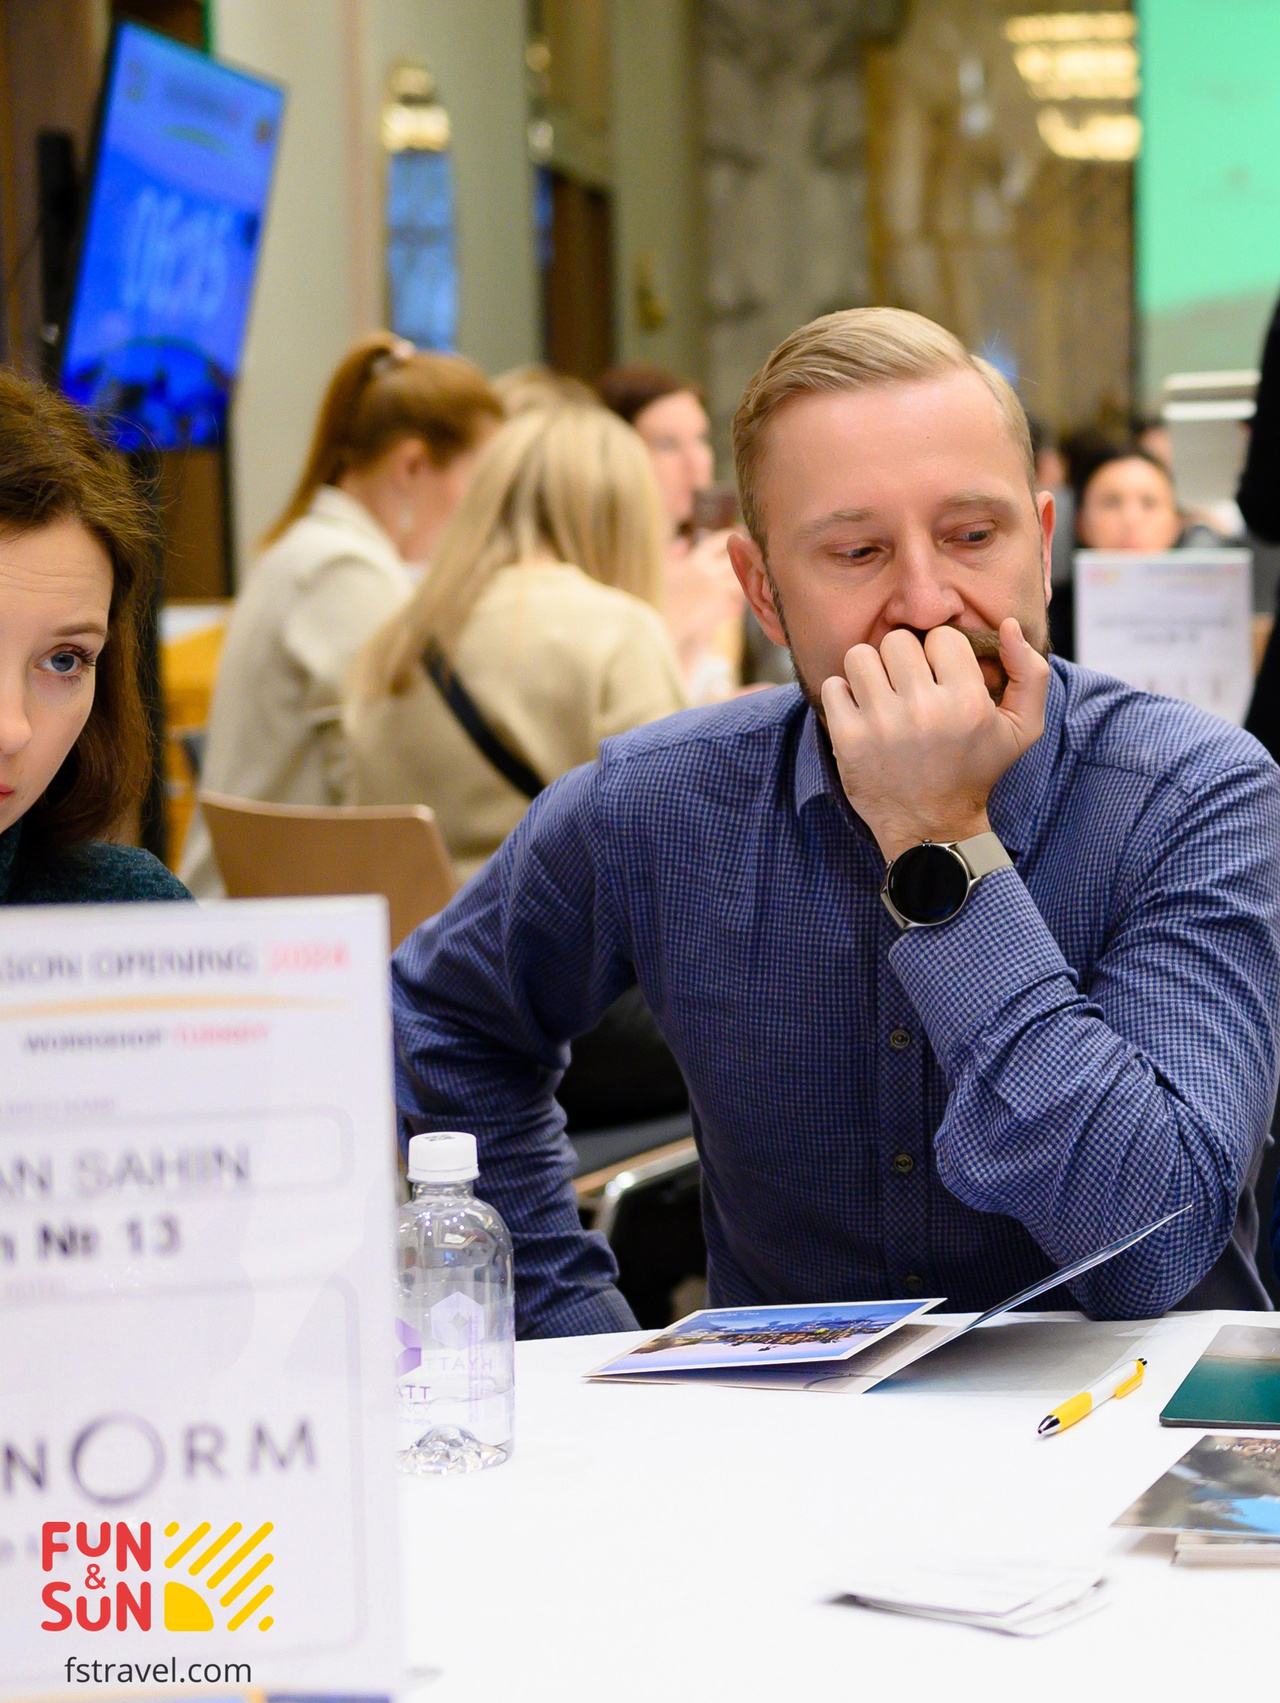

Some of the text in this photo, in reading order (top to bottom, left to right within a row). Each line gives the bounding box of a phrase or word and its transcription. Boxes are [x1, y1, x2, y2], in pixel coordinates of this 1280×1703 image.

[92, 944, 256, 980] OPENING
[24, 1028, 162, 1053] WORKSHOP
[71, 1141, 250, 1199] SAHIN
[124, 1210, 183, 1259] 13
[395, 1384, 431, 1400] ATT
[2, 1411, 319, 1507] NORM
